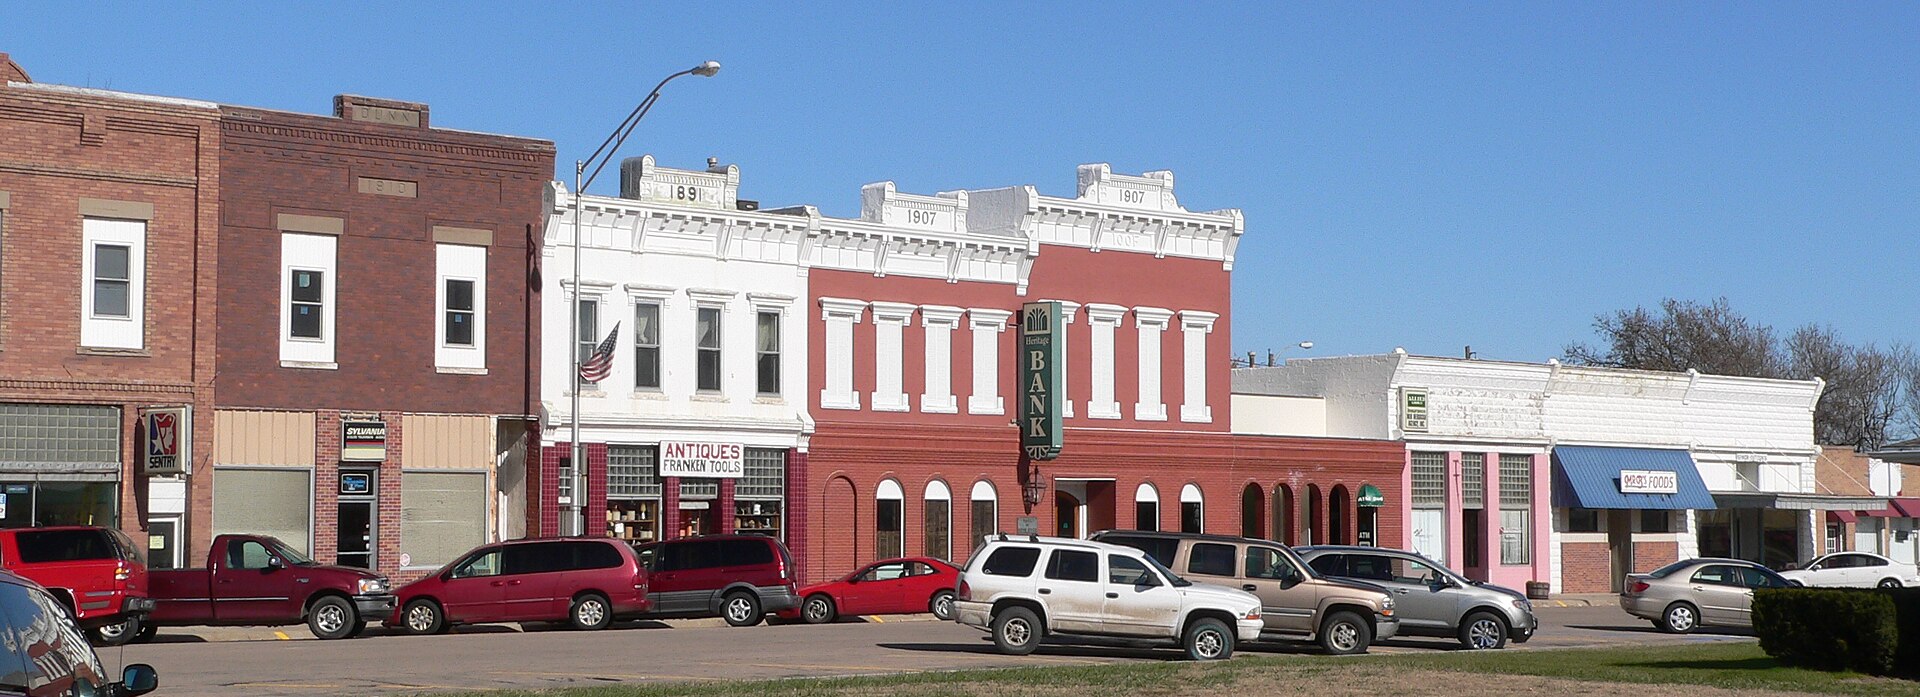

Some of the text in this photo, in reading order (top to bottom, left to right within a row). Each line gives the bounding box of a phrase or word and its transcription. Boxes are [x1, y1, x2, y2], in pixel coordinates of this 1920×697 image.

[361, 107, 410, 122] DUNN
[670, 184, 702, 202] 1891
[1119, 188, 1145, 204] 1907
[908, 209, 937, 226] 1907
[1025, 336, 1050, 346] Heritage
[1029, 350, 1046, 437] BANK
[346, 427, 386, 436] SYLVANIA
[665, 442, 740, 459] ANTIQUES
[149, 456, 177, 469] SENTRY
[663, 459, 741, 473] FRANKEN TOOLS
[1648, 476, 1674, 488] FOODS
